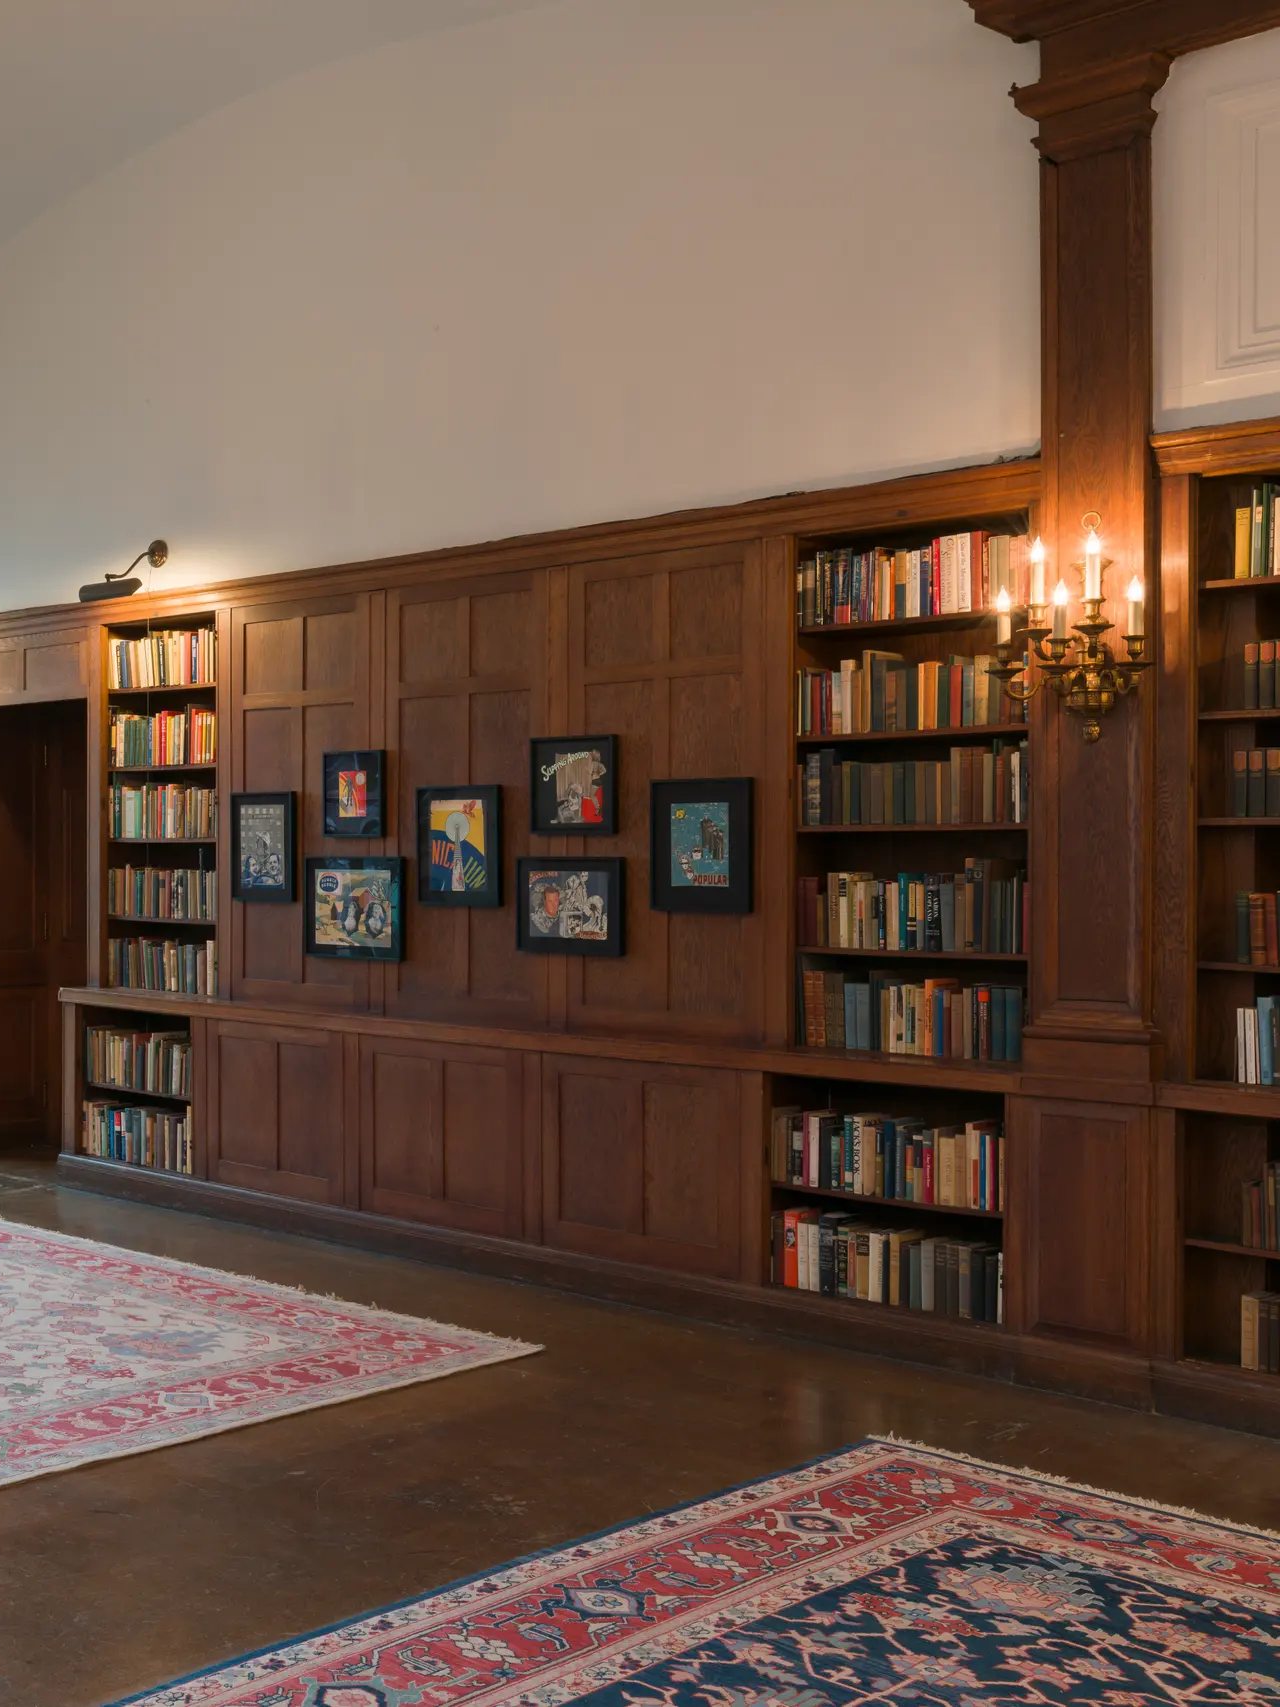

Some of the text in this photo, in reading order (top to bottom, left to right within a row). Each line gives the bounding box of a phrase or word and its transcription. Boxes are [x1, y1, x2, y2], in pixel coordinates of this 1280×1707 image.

[541, 751, 589, 782] SLIPPING AROUND
[431, 839, 455, 869] NIC
[693, 874, 727, 885] POPULAR
[852, 1120, 861, 1175] JACK'S BOOK
